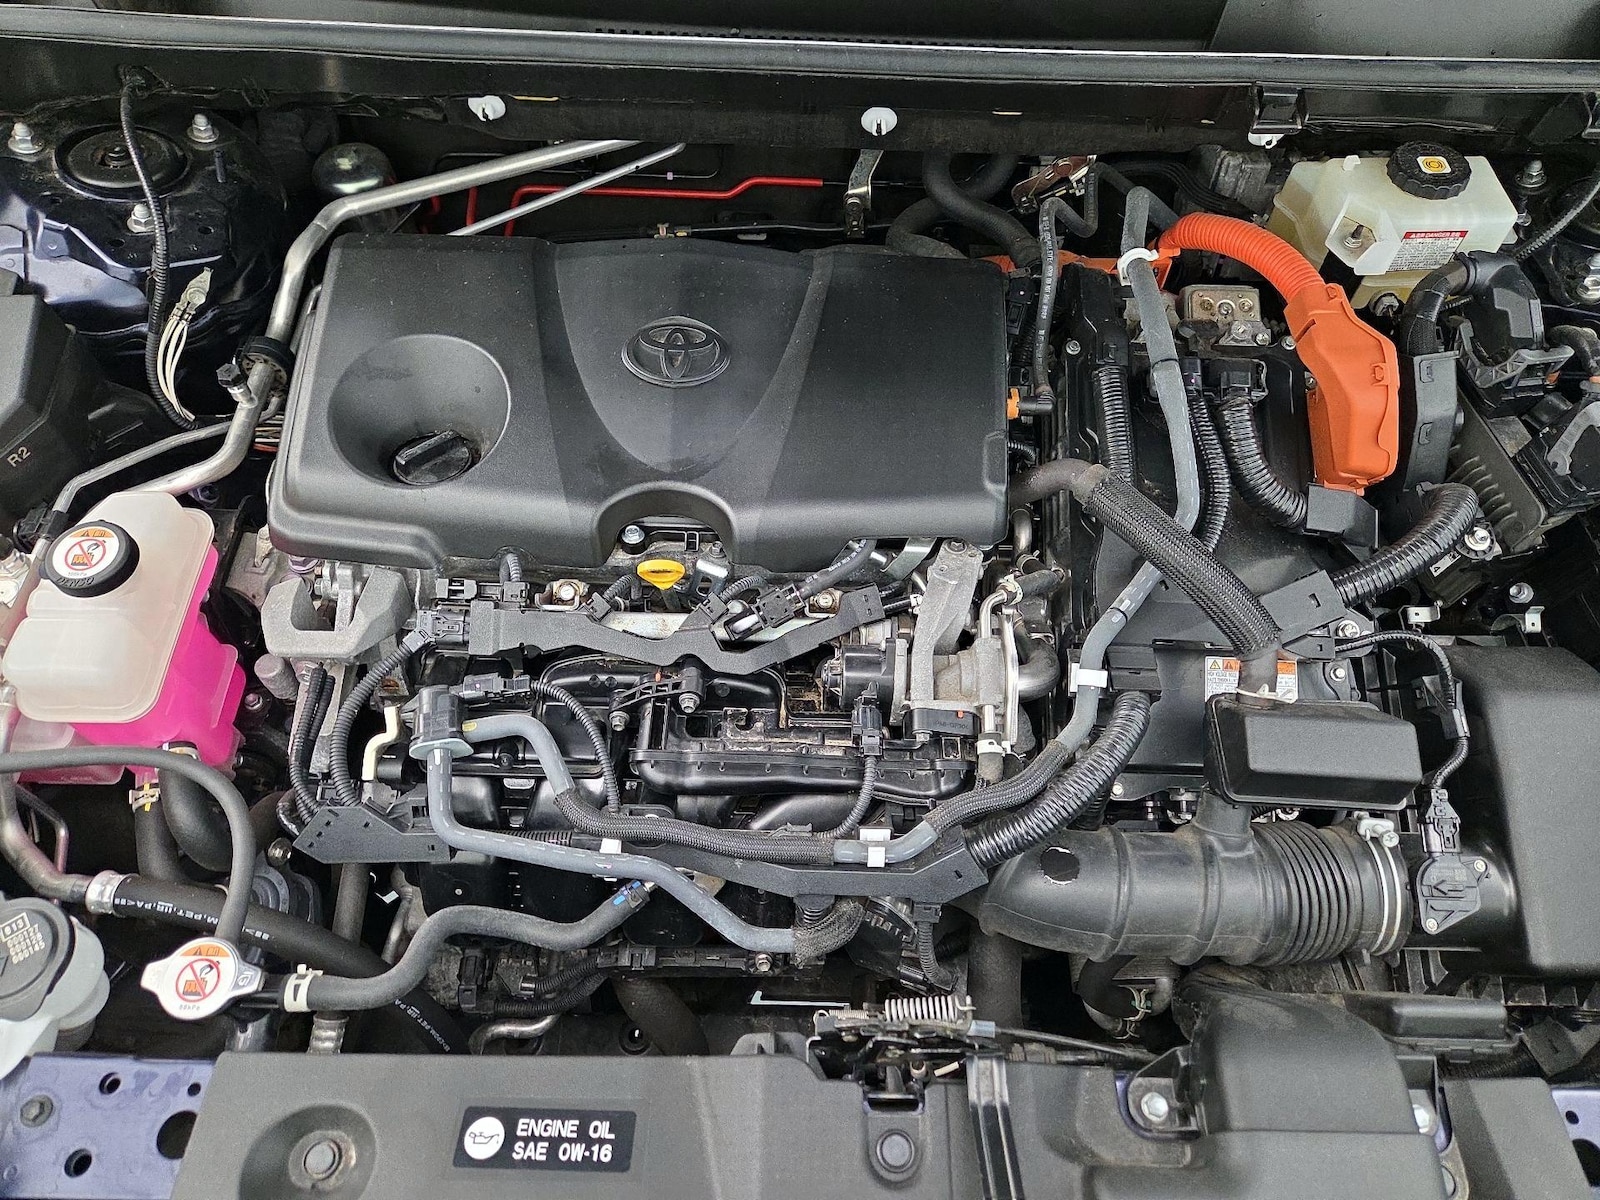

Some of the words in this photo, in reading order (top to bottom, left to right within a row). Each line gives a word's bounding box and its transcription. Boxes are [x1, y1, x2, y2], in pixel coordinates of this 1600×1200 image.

[7, 446, 31, 467] R2
[515, 1118, 579, 1138] ENGINE
[588, 1120, 615, 1139] OIL
[511, 1141, 549, 1161] SAE
[558, 1143, 613, 1163] 0W-16
